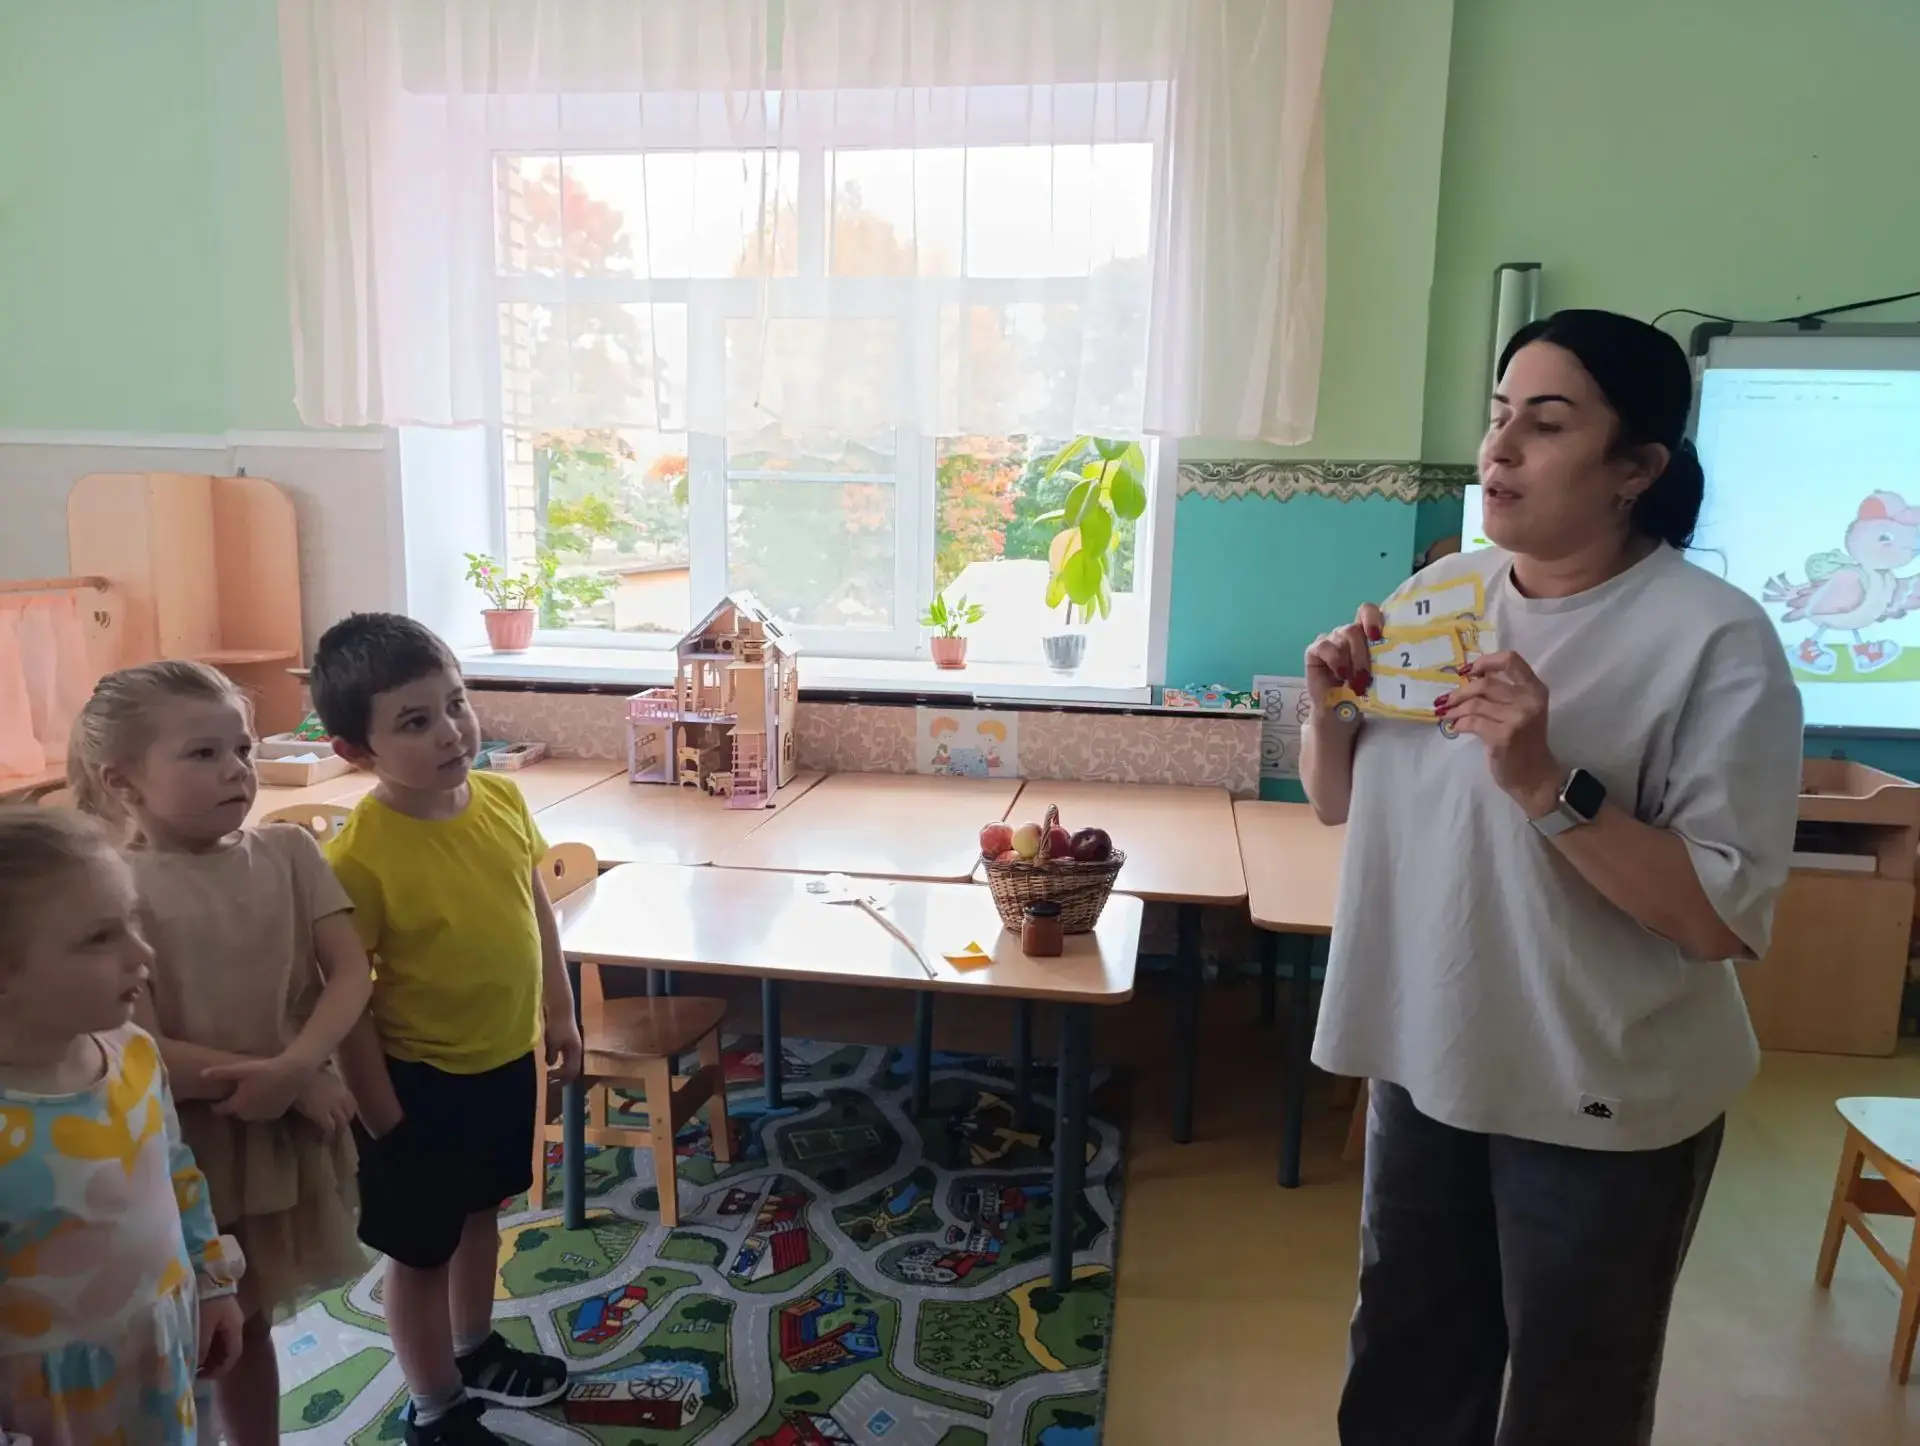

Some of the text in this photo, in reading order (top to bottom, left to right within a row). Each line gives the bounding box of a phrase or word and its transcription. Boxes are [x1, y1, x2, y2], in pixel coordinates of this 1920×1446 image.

[1415, 599, 1430, 615] 11
[1400, 652, 1411, 668] 2
[1400, 684, 1406, 699] 1
